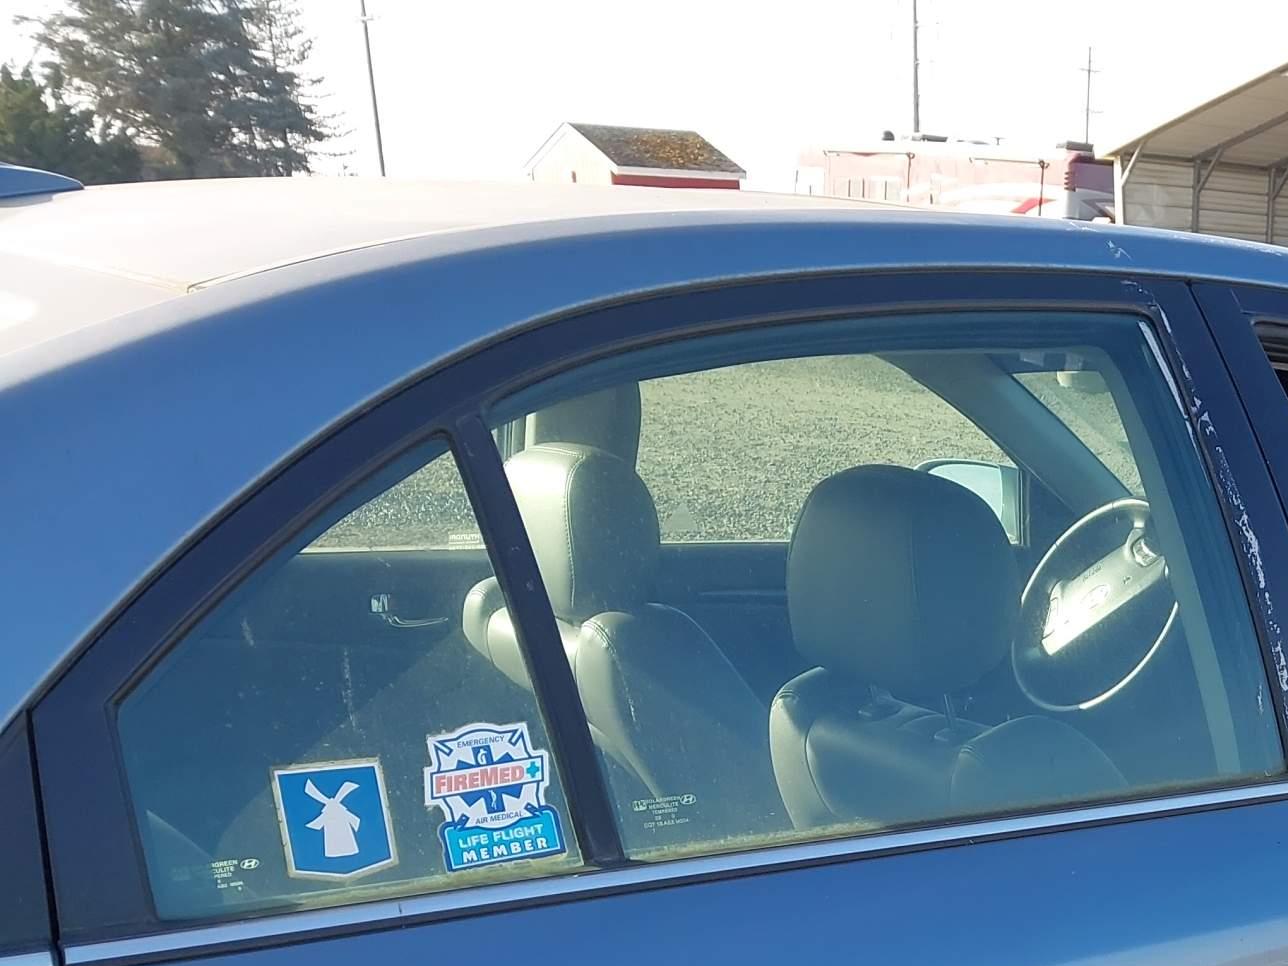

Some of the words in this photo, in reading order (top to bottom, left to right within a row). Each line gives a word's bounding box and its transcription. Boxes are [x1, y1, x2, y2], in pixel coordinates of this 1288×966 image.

[456, 735, 505, 749] EMERGENCY
[475, 815, 489, 825] AIR
[490, 811, 523, 823] MEDICAL
[458, 833, 489, 849] LIFE
[493, 823, 544, 843] FLIGHT
[462, 837, 549, 864] MEMBER
